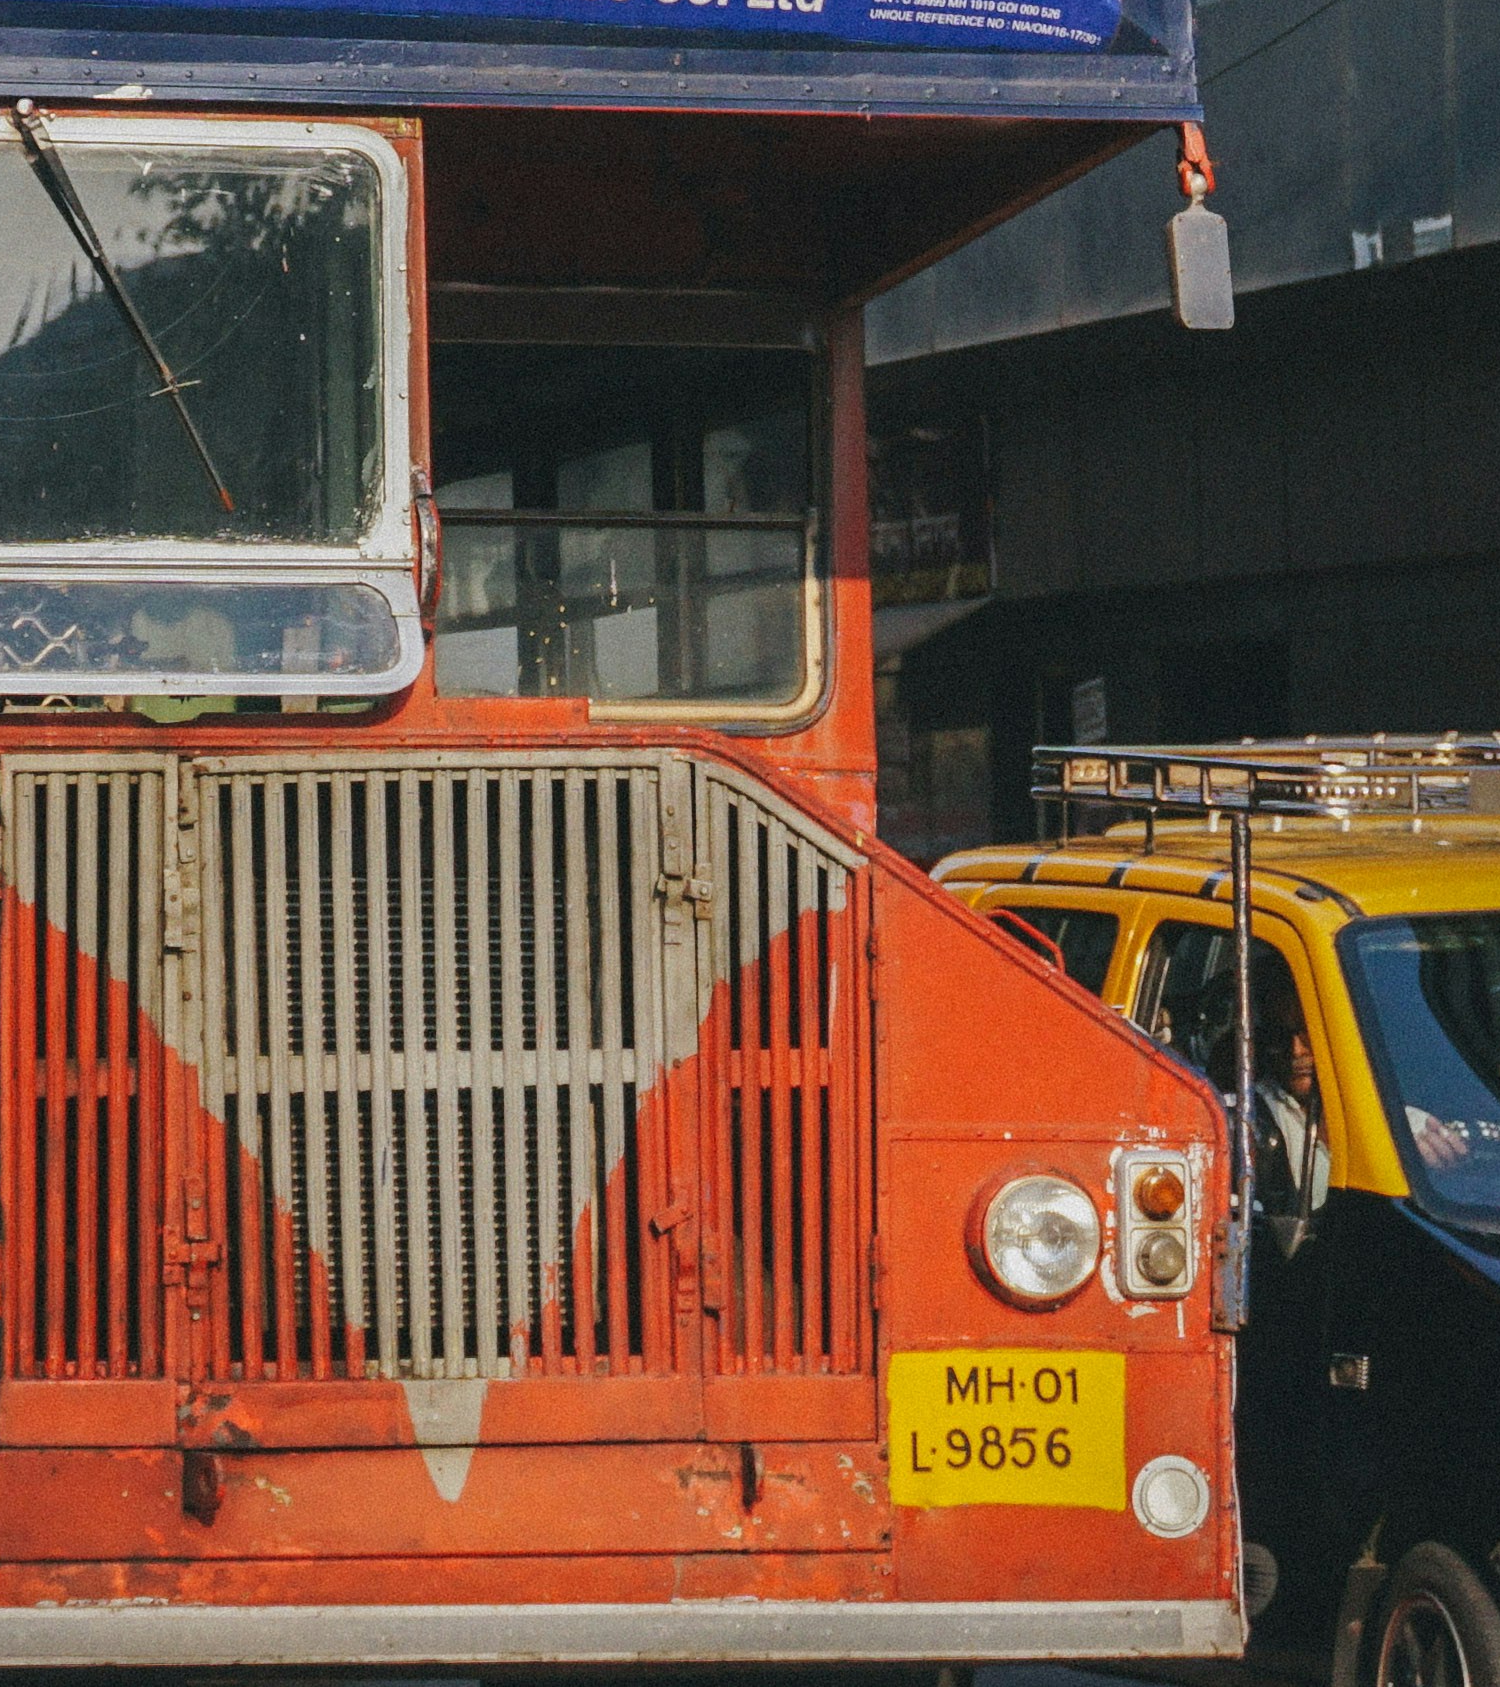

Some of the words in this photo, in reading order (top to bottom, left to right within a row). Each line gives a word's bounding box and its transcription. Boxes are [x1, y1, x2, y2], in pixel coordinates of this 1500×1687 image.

[869, 7, 914, 24] UNIQUE
[915, 11, 985, 29] REFERENCE
[985, 16, 1005, 30] NO
